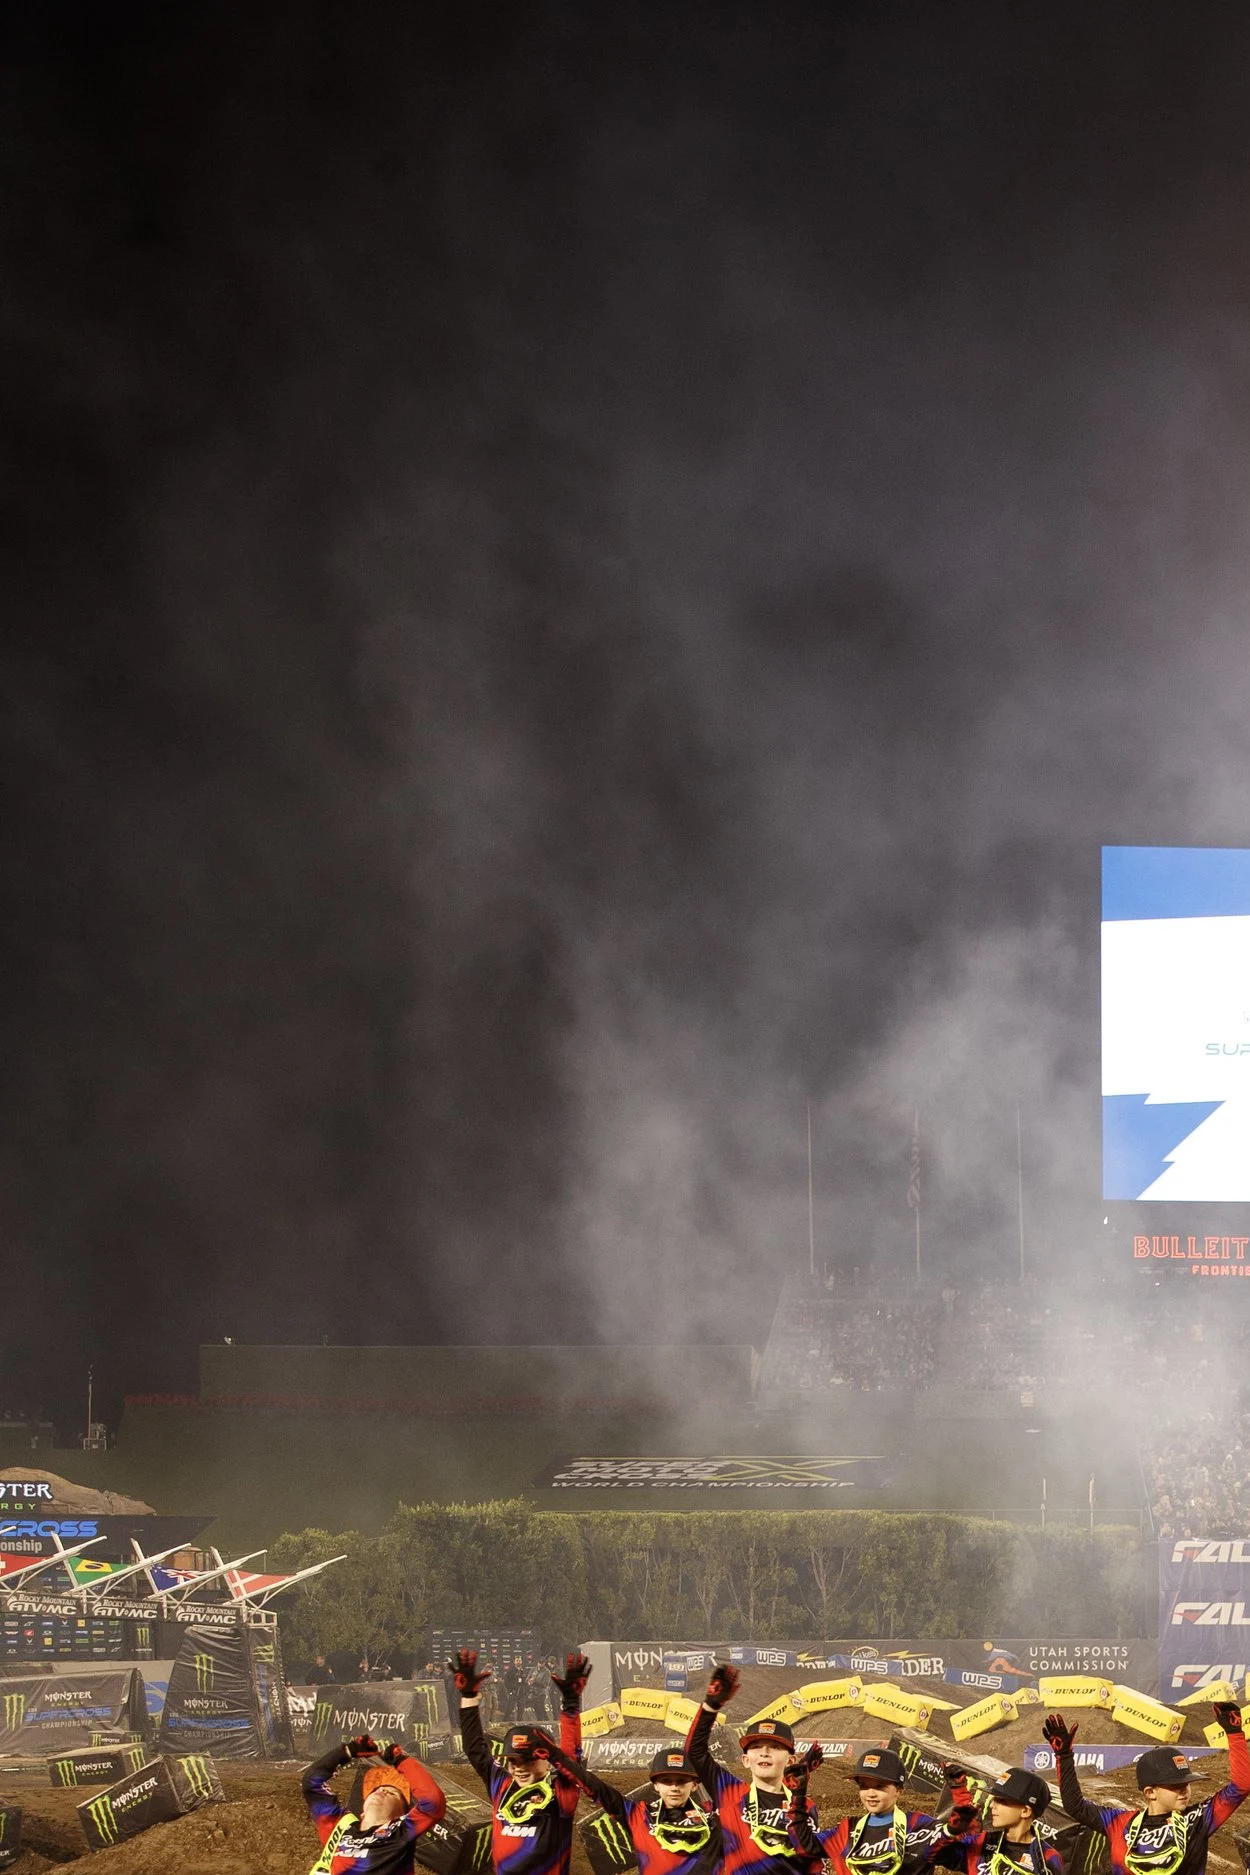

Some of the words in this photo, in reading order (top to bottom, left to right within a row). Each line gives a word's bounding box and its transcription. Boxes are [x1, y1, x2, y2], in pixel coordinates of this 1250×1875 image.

[1134, 1236, 1250, 1259] BULLEIT
[18, 1593, 41, 1603] ROCKY
[42, 1595, 77, 1606] MOUNTAIN
[103, 1599, 125, 1607] ROCKY
[127, 1600, 158, 1610] MOUNTAIN
[186, 1604, 208, 1613] ROCKY
[209, 1606, 236, 1615] MOUNTAIN
[756, 1650, 787, 1667] WPS
[1029, 1646, 1067, 1657] UTAH
[1074, 1646, 1128, 1657] SPORTS
[687, 1655, 705, 1671] WPS
[851, 1658, 888, 1675] WPS
[1029, 1659, 1128, 1671] COMMISSION
[961, 1671, 1003, 1689] WPS
[44, 1691, 92, 1702] MONSTER
[184, 1698, 228, 1709] MONSTER
[810, 1693, 845, 1704] DUNLOP
[629, 1699, 664, 1709] DUNLOP
[876, 1696, 916, 1714] DUNLOP
[333, 1708, 406, 1732] MONSTER
[960, 1703, 997, 1726] DUNLOP
[1124, 1706, 1167, 1729] DUNLOP
[598, 1740, 663, 1756] MONSTER
[75, 1761, 113, 1772] MONSTER
[112, 1776, 158, 1810] MONSTER
[501, 1825, 537, 1838] KTM
